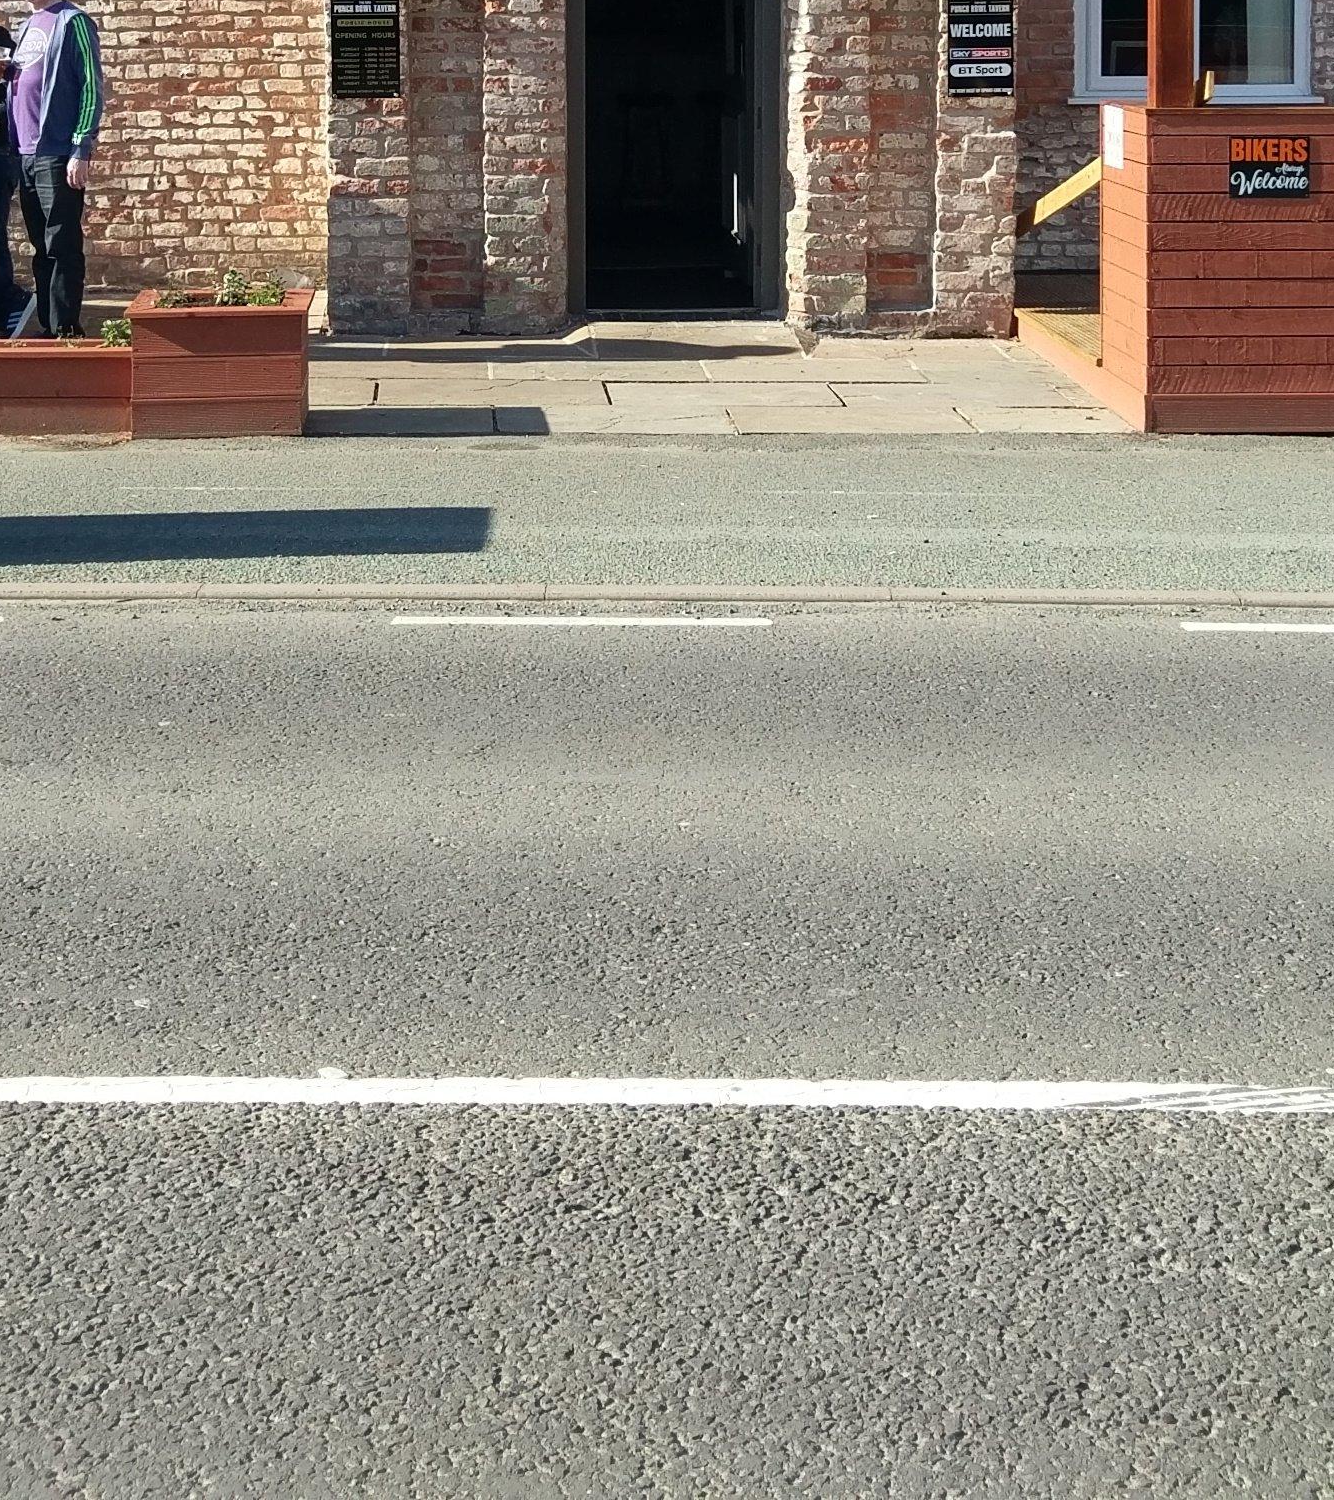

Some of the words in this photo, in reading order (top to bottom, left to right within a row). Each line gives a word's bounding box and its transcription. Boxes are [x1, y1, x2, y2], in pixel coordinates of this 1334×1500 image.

[950, 23, 1012, 37] WELCOME
[958, 66, 974, 75] BT
[976, 66, 1003, 75] Sport
[1231, 138, 1308, 162] BIKERS
[1230, 169, 1309, 196] Welcome
